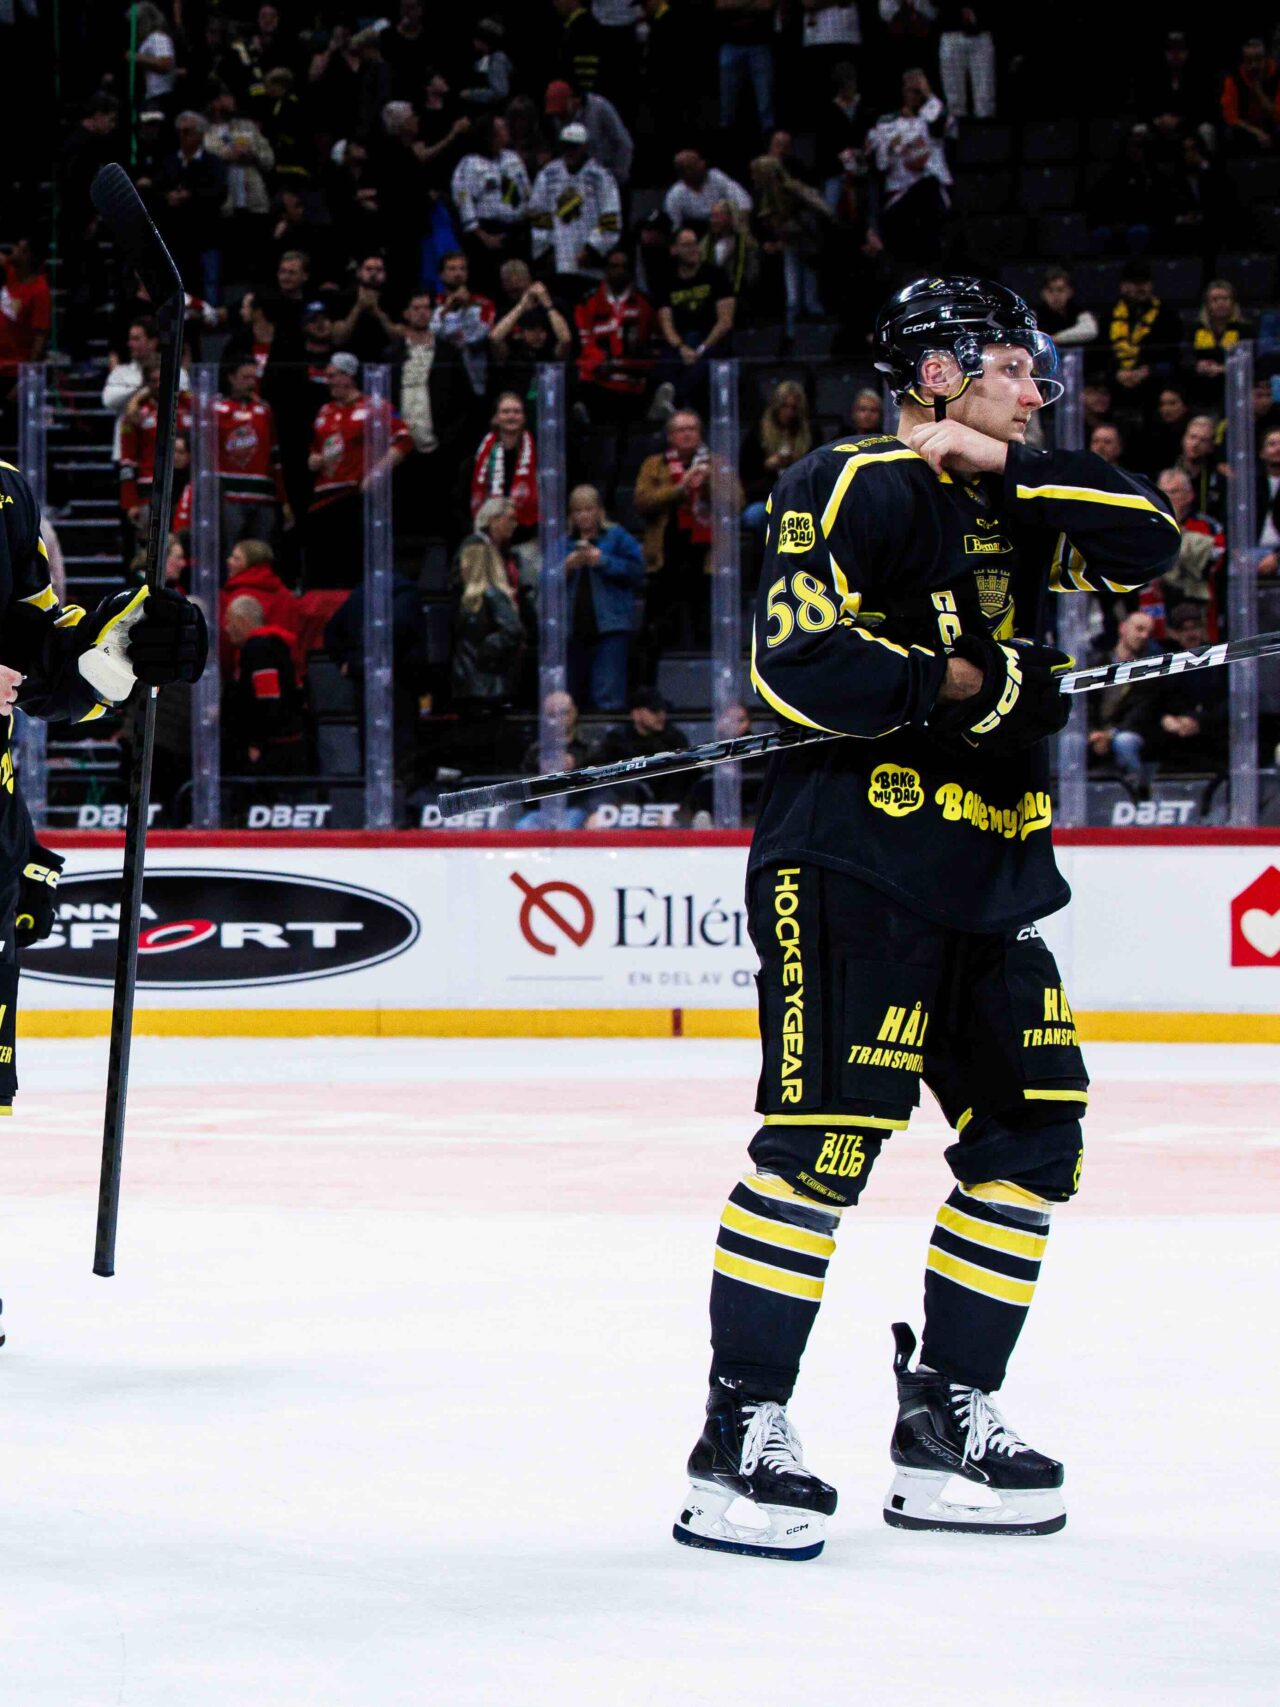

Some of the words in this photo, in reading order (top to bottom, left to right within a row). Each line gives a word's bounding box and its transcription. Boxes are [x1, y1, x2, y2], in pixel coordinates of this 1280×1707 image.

[903, 321, 936, 335] CCM
[1024, 316, 1037, 330] CC
[966, 369, 983, 377] CCM
[766, 570, 837, 648] 58
[930, 590, 964, 655] CC
[1059, 642, 1229, 694] CCM
[77, 804, 162, 828] DBT
[248, 804, 332, 828] DBET
[422, 804, 508, 828] DBET
[595, 804, 680, 828] DBET
[1112, 801, 1196, 826] DBET
[23, 863, 60, 889] CC
[26, 918, 364, 955] SPORT
[1017, 926, 1041, 941] CC
[775, 867, 805, 1104] HOCKEYGEAR
[1043, 981, 1074, 1023] HÅ
[876, 1001, 929, 1047] HÅJ
[1023, 1028, 1080, 1048] TRANSPO
[815, 1149, 866, 1178] CLUB
[786, 1522, 809, 1535] CCM
